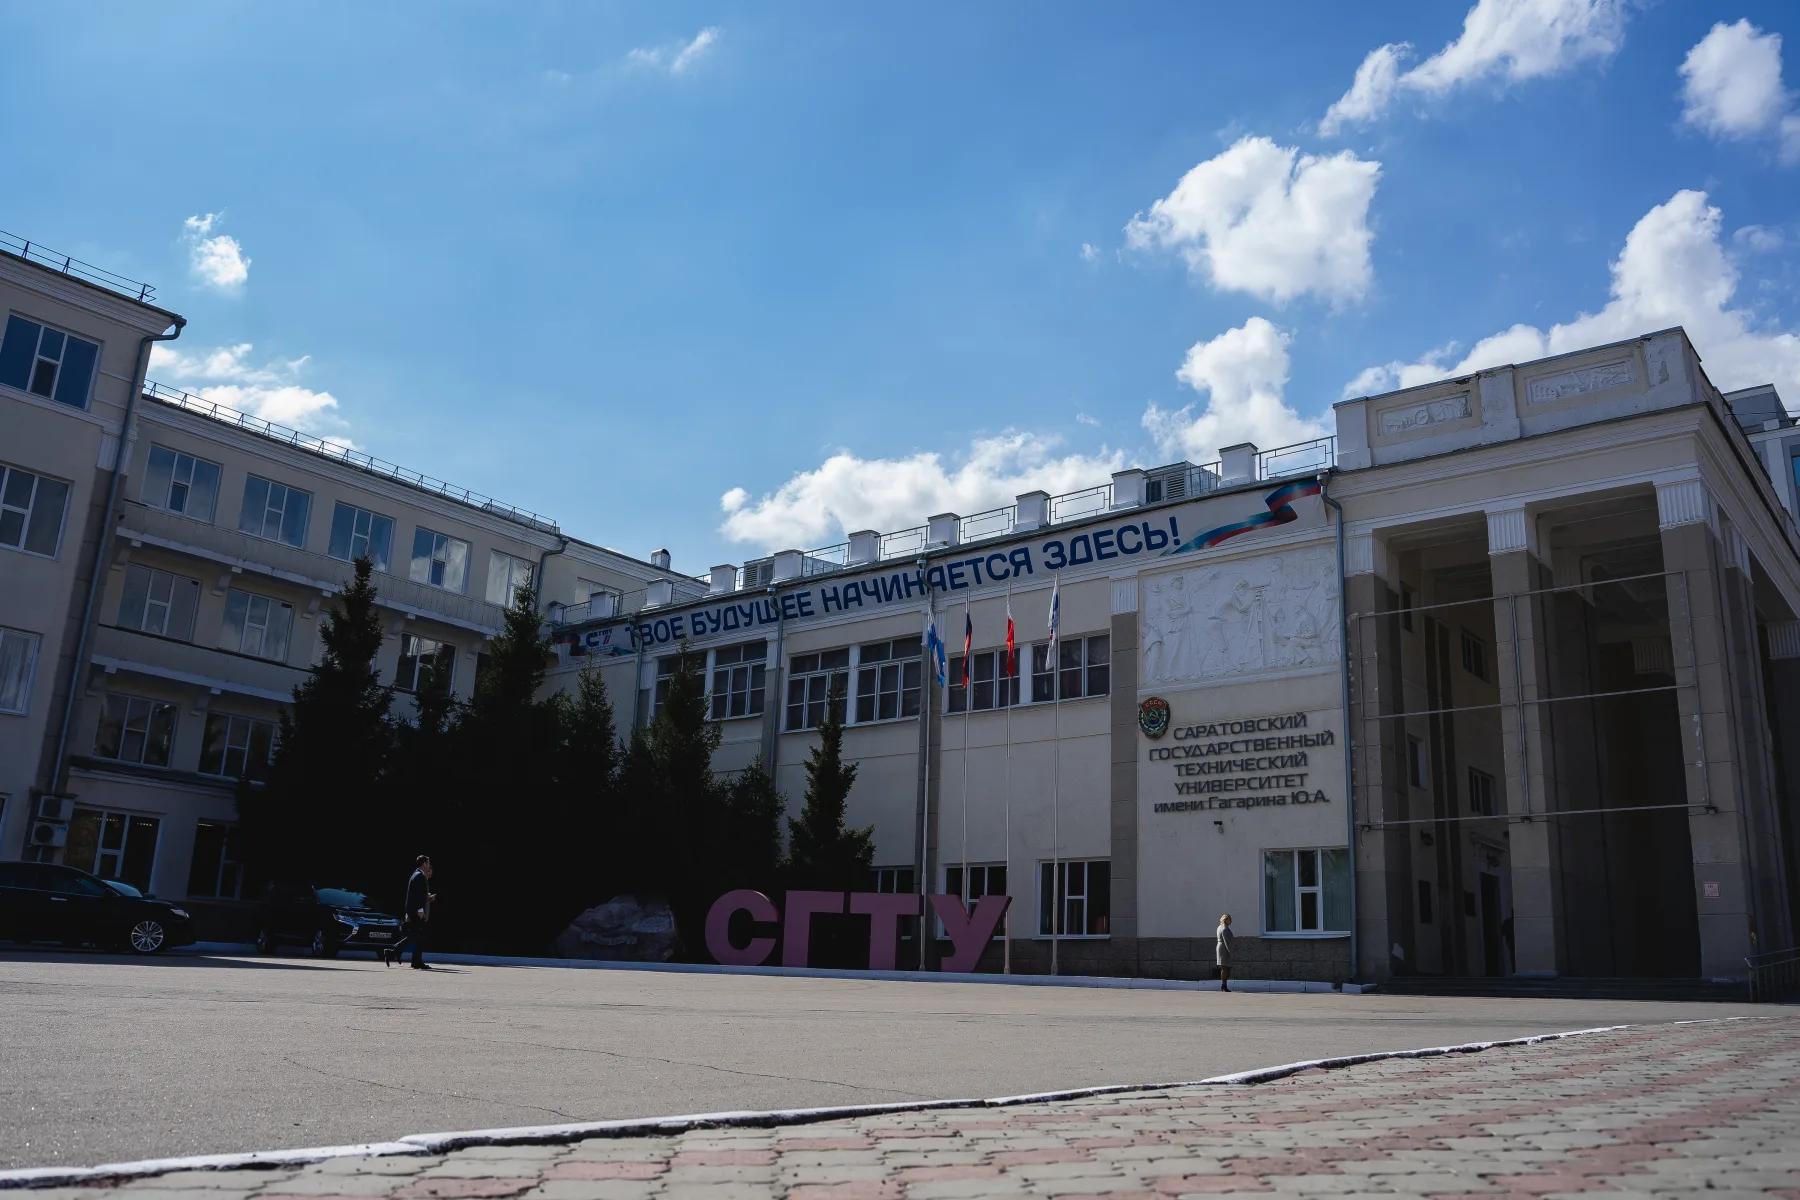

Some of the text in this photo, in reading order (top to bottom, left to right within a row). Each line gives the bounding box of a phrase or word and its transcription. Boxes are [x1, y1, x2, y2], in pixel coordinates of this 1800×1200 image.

[625, 516, 1181, 648] ТВОЕ БУДУЩЕЕ НАЧИНАЕТСЯ ЗДЕСЬ!
[1173, 711, 1308, 741] САРАТОВСКИЙ
[1149, 729, 1335, 762] ГОСУДАРСТВЕННЫЙ
[1173, 751, 1308, 777] ТЕХНИЧЕСКИЙ
[1174, 773, 1309, 795] УНИВЕРСИТЕТ
[1154, 789, 1330, 813] имени Гагарина Ю.А.
[704, 889, 1013, 973] СГТУ
